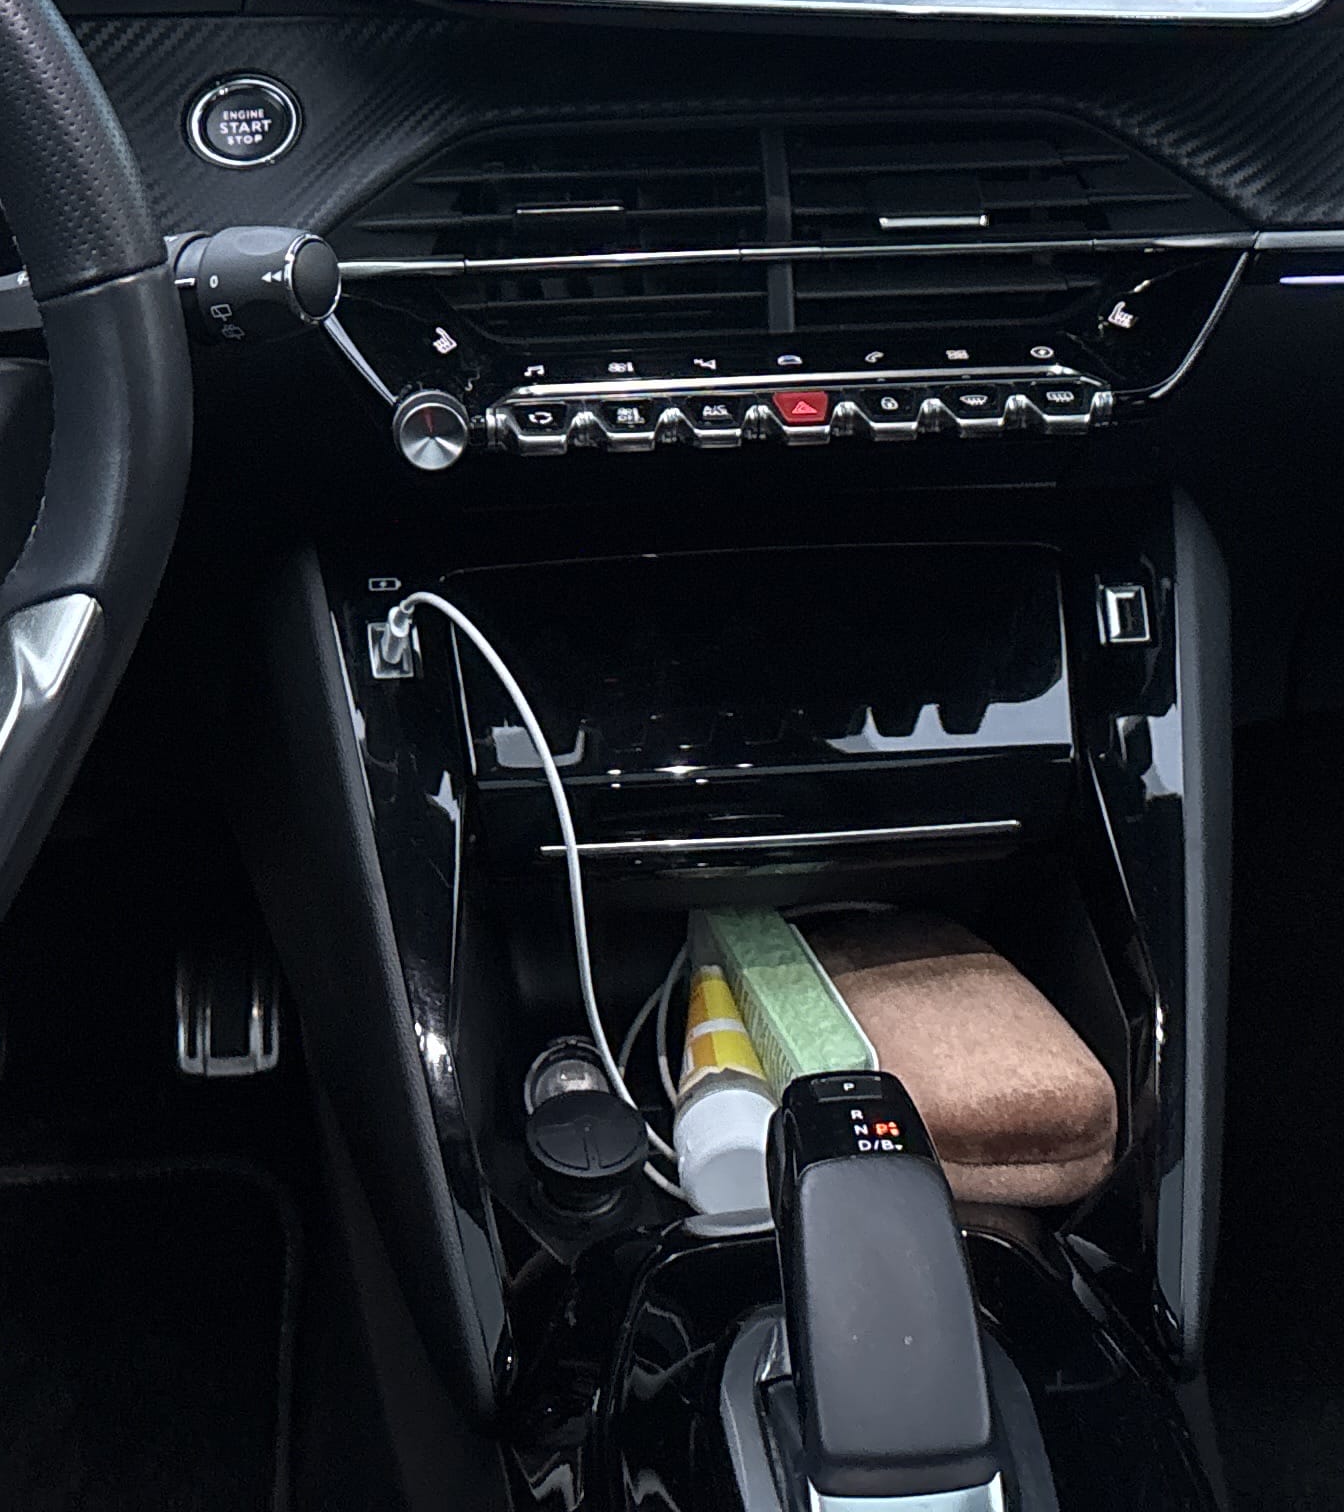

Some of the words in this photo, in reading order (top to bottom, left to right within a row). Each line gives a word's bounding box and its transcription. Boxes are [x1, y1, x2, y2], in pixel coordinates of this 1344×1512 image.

[223, 109, 264, 120] ENGINE
[219, 119, 272, 134] START
[227, 134, 263, 145] STOP
[843, 1083, 855, 1091] P
[850, 1109, 863, 1120] R
[853, 1124, 868, 1136] N
[858, 1140, 894, 1151] D/B
